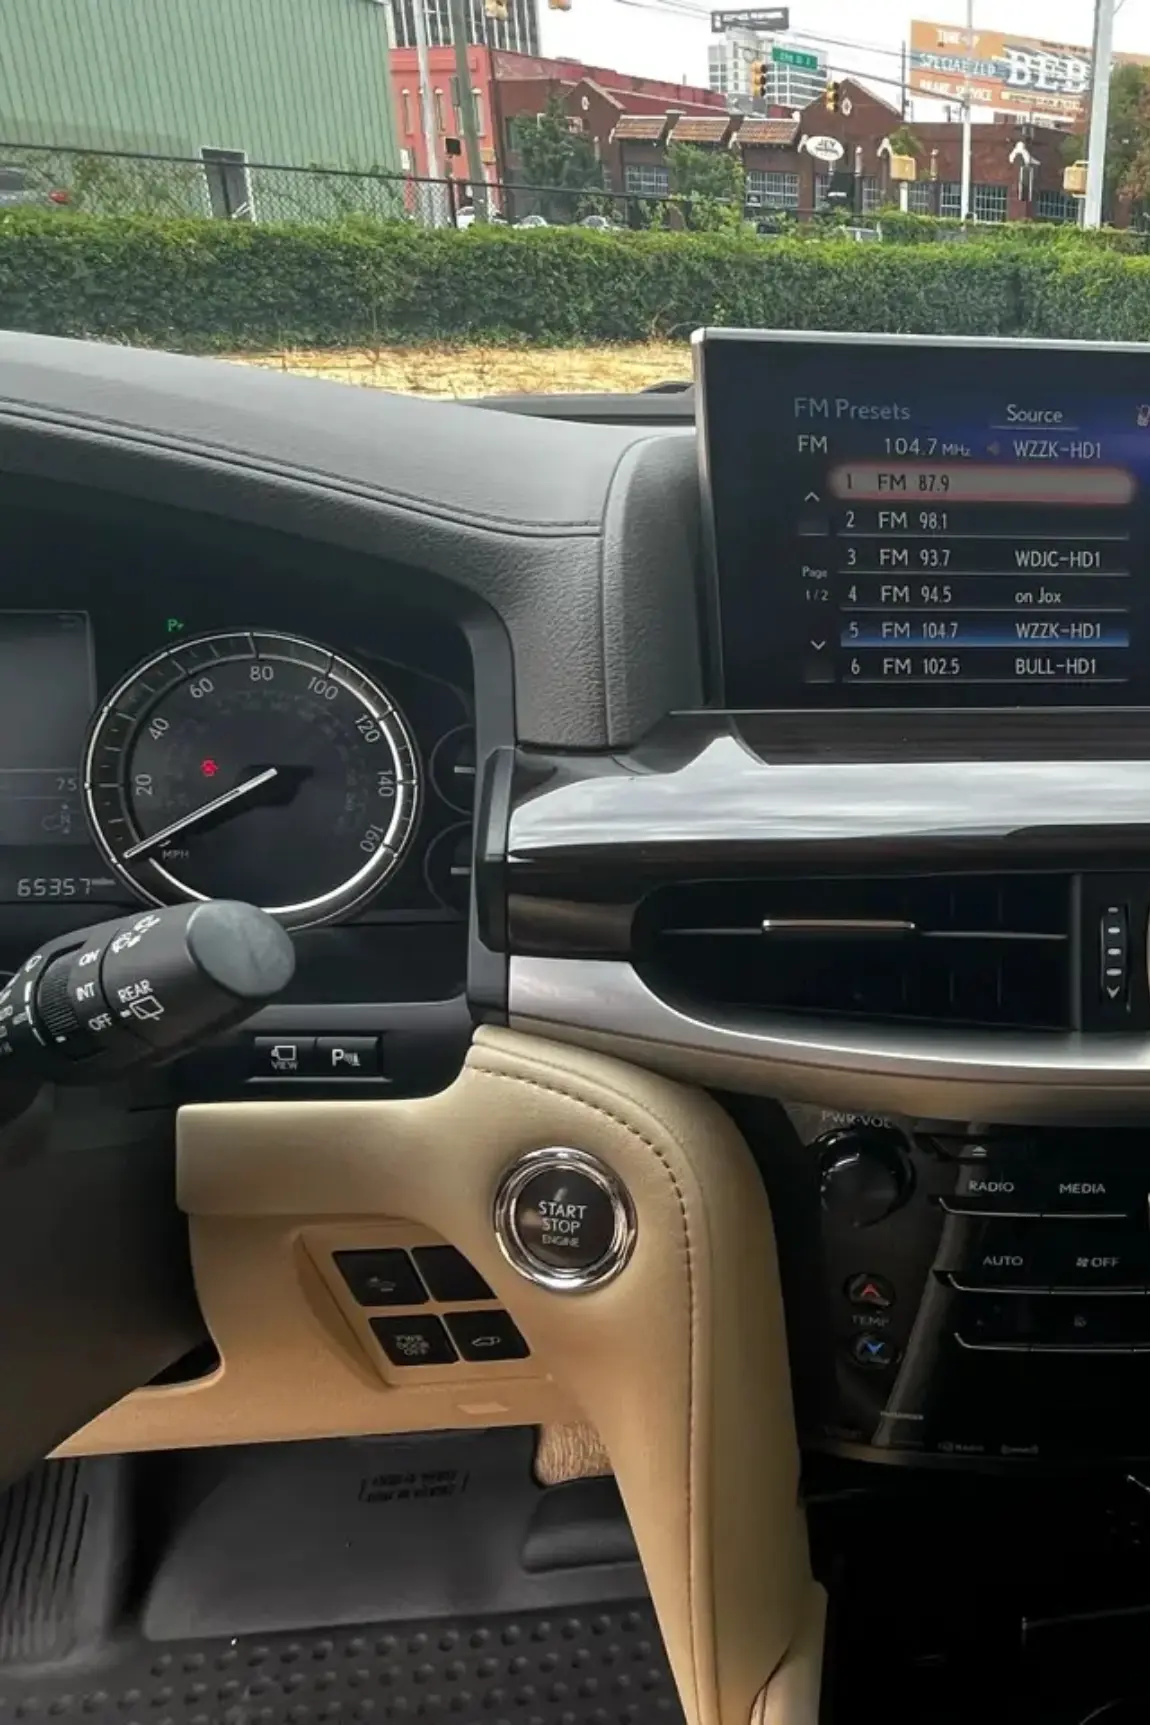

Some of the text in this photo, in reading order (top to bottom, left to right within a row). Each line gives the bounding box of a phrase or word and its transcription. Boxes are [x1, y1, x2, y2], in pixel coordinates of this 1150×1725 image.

[793, 397, 911, 421] FM Presets
[1006, 404, 1063, 424] Source
[797, 435, 1101, 460] FM 104.7 MHz WZZK-HD1
[846, 474, 950, 492] 1 FM 87.9
[846, 511, 948, 530] 2 FM 98.1
[847, 549, 1101, 568] 3 FM 93.7 WDJC-HD1
[802, 566, 828, 580] Page
[848, 585, 1062, 605] 4 FM 94.5 on Jox
[849, 622, 1101, 640] 5 FM 104.7 WZZK-HD1
[249, 665, 274, 682] 80
[852, 658, 1097, 676] 6 FM 102.5 BULL-HD1
[189, 677, 215, 699] 60
[306, 676, 340, 701] 100
[148, 716, 171, 741] 40
[354, 713, 381, 745] 120
[135, 773, 154, 797] 20
[376, 769, 394, 798] 140
[359, 825, 385, 853] 160
[162, 848, 190, 860] MPH
[17, 876, 92, 896] 65357
[117, 978, 155, 1003] REAR
[88, 1012, 113, 1032] OFF
[968, 1179, 1015, 1194] RADIO
[1059, 1183, 1106, 1195] MEDIA
[538, 1200, 587, 1220] START
[541, 1217, 580, 1234] STOP
[542, 1233, 580, 1248] ENGINE
[983, 1255, 1023, 1268] AUTO
[1090, 1256, 1119, 1268] OFF
